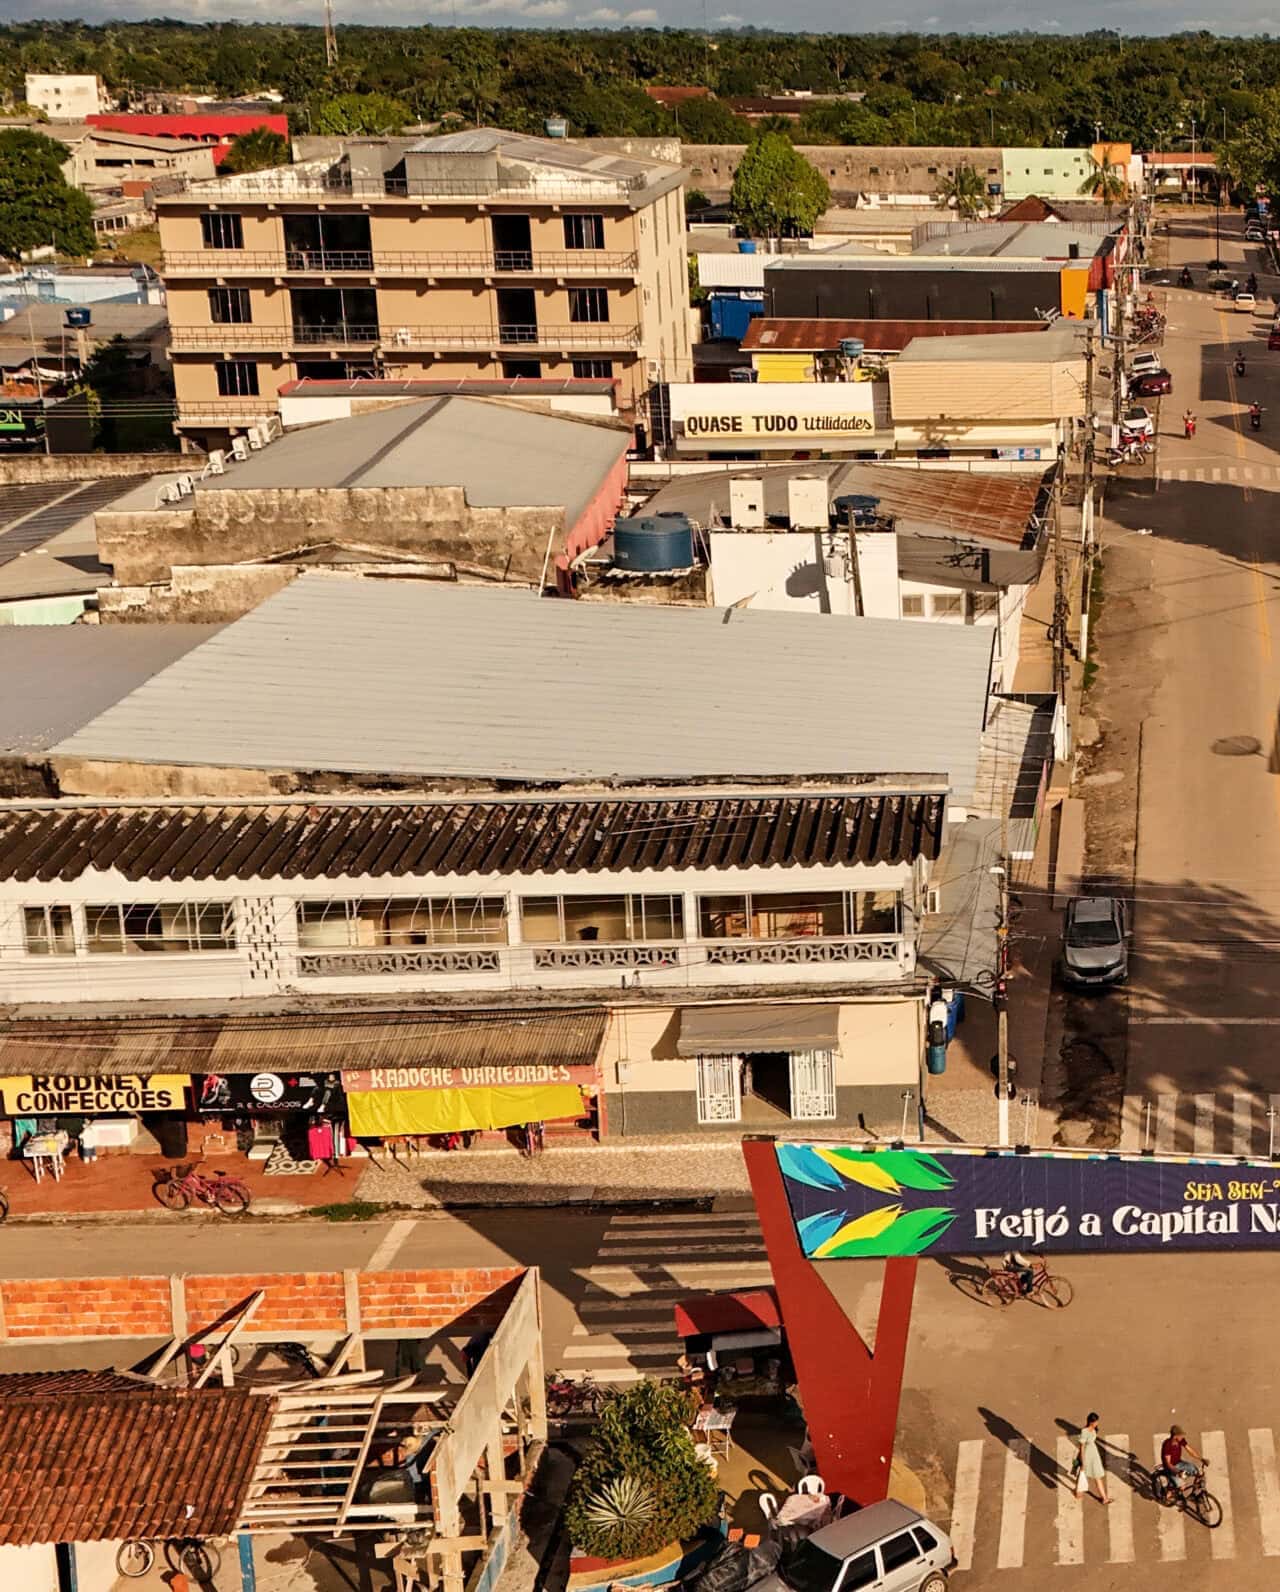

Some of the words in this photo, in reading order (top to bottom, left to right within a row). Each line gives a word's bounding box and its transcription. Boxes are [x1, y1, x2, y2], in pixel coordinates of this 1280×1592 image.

[687, 416, 742, 434] QUASE
[752, 415, 798, 432] TUDO
[32, 1074, 152, 1091] RODNEY
[974, 1205, 1070, 1246] Feijó
[1079, 1213, 1102, 1236] a
[1112, 1203, 1239, 1242] Capital
